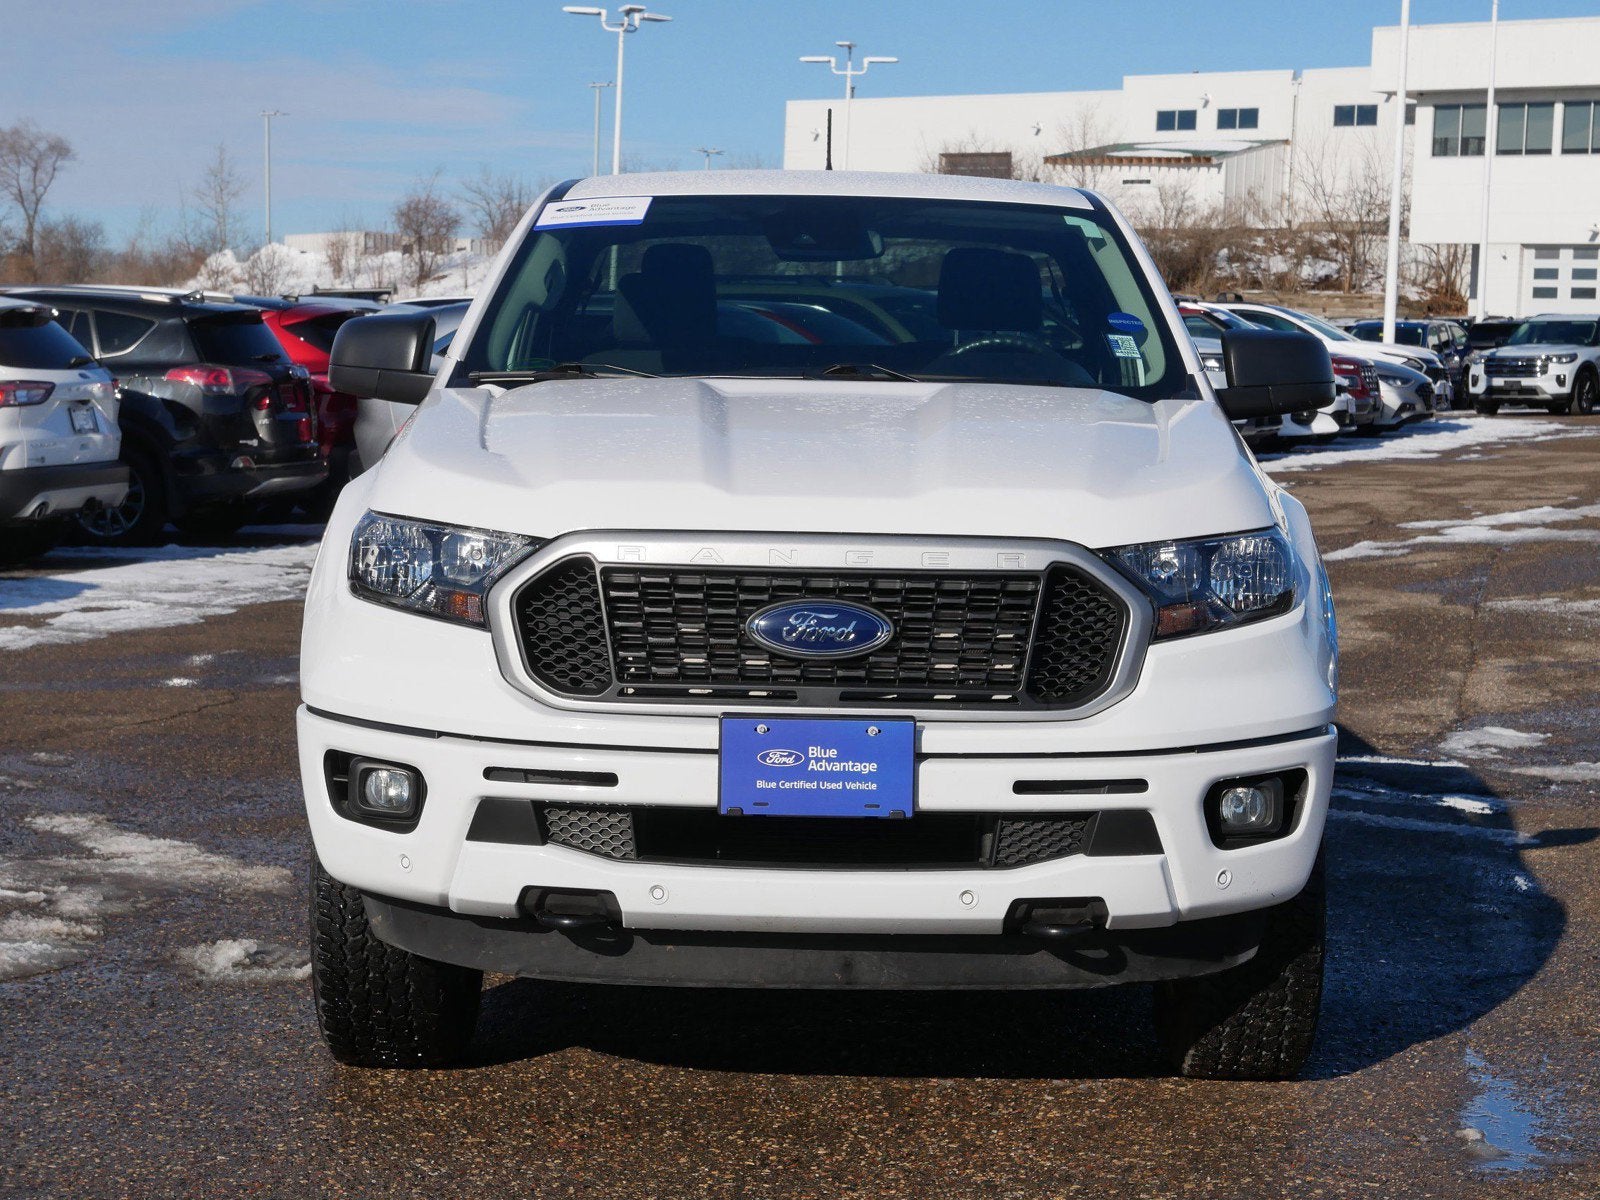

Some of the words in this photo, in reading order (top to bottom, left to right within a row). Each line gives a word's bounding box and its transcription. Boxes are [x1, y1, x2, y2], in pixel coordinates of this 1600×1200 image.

[616, 545, 1026, 569] RANGER
[782, 611, 858, 643] Ford
[765, 750, 796, 765] Ford
[808, 746, 837, 758] Blue
[808, 759, 877, 774] Advantage
[756, 779, 777, 789] Blue
[779, 780, 817, 789] Certified
[819, 781, 843, 790] Used
[844, 781, 878, 790] Vehicle
